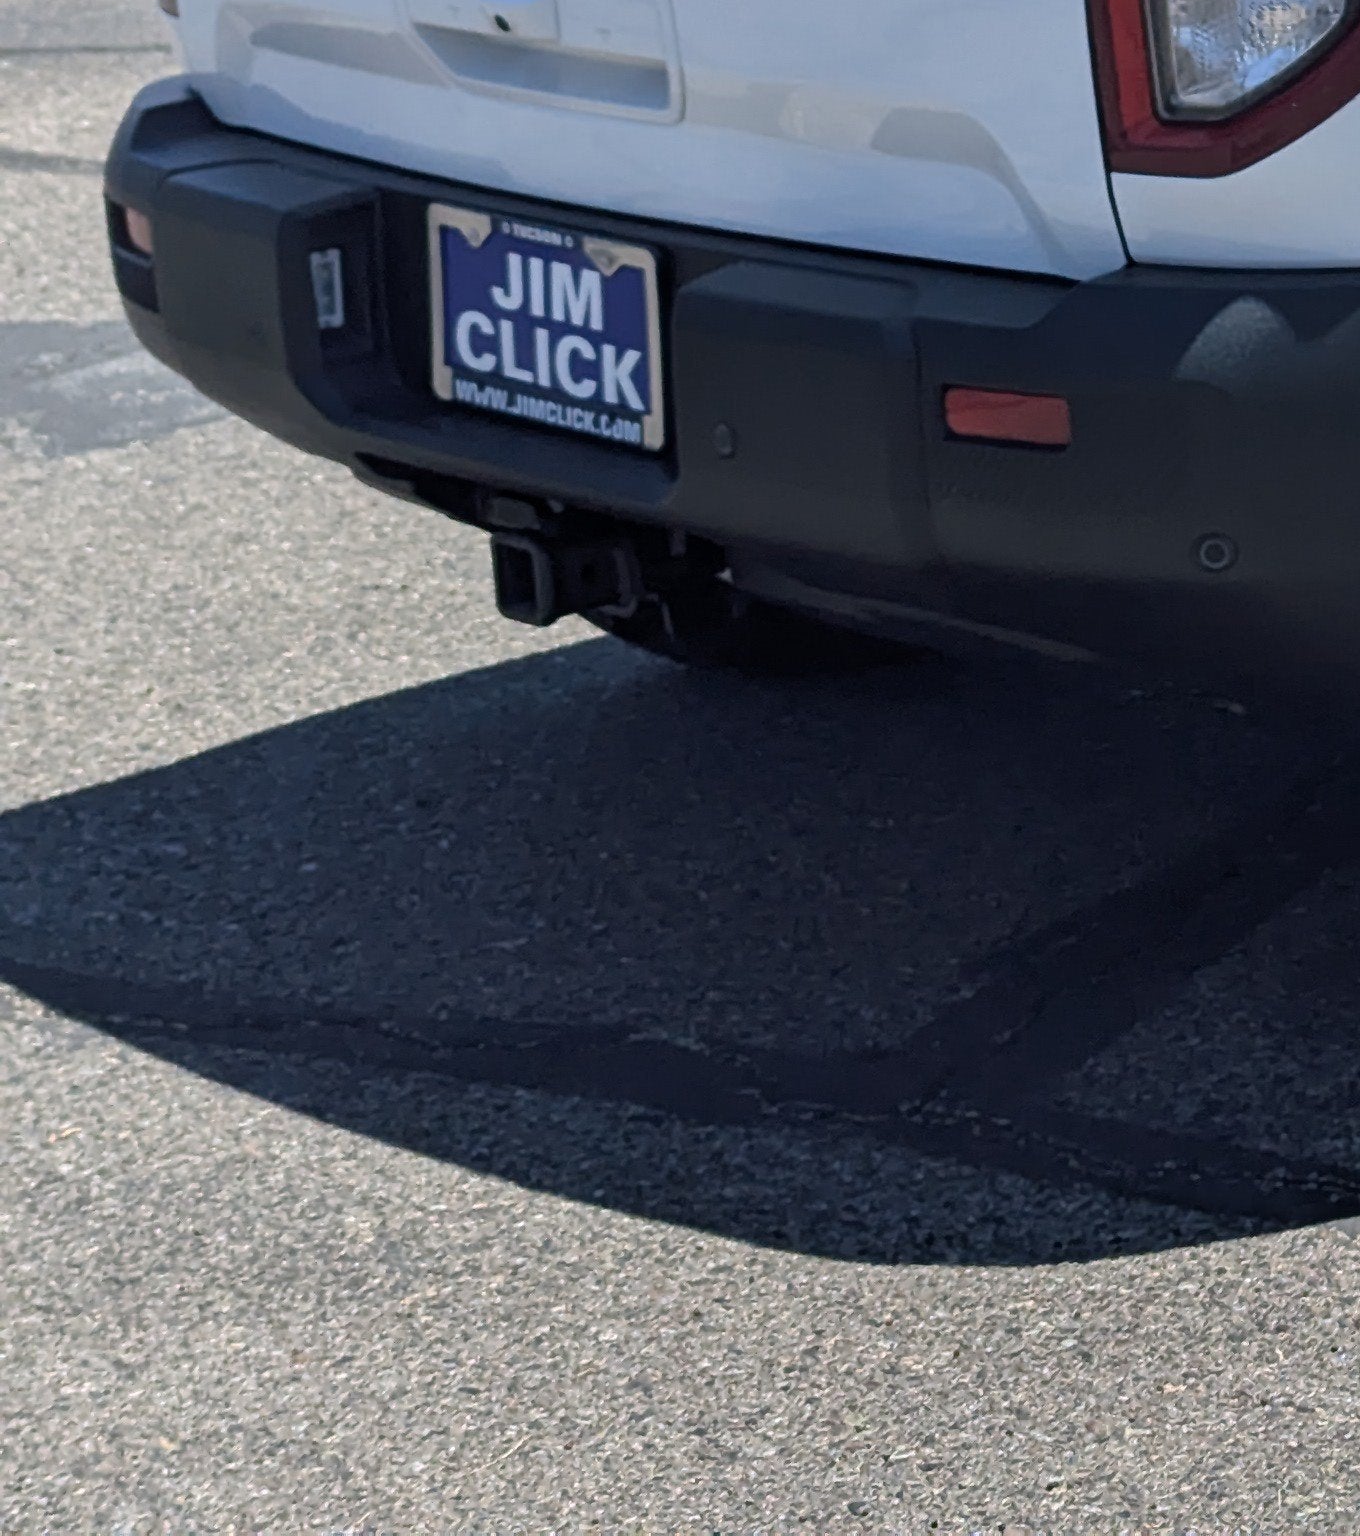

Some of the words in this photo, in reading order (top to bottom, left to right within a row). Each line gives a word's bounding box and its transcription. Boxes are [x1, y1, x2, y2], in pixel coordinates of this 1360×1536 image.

[490, 251, 603, 331] JIM
[456, 310, 646, 412] CLICK
[455, 378, 642, 444] WWW.JIMCLICK.COM
